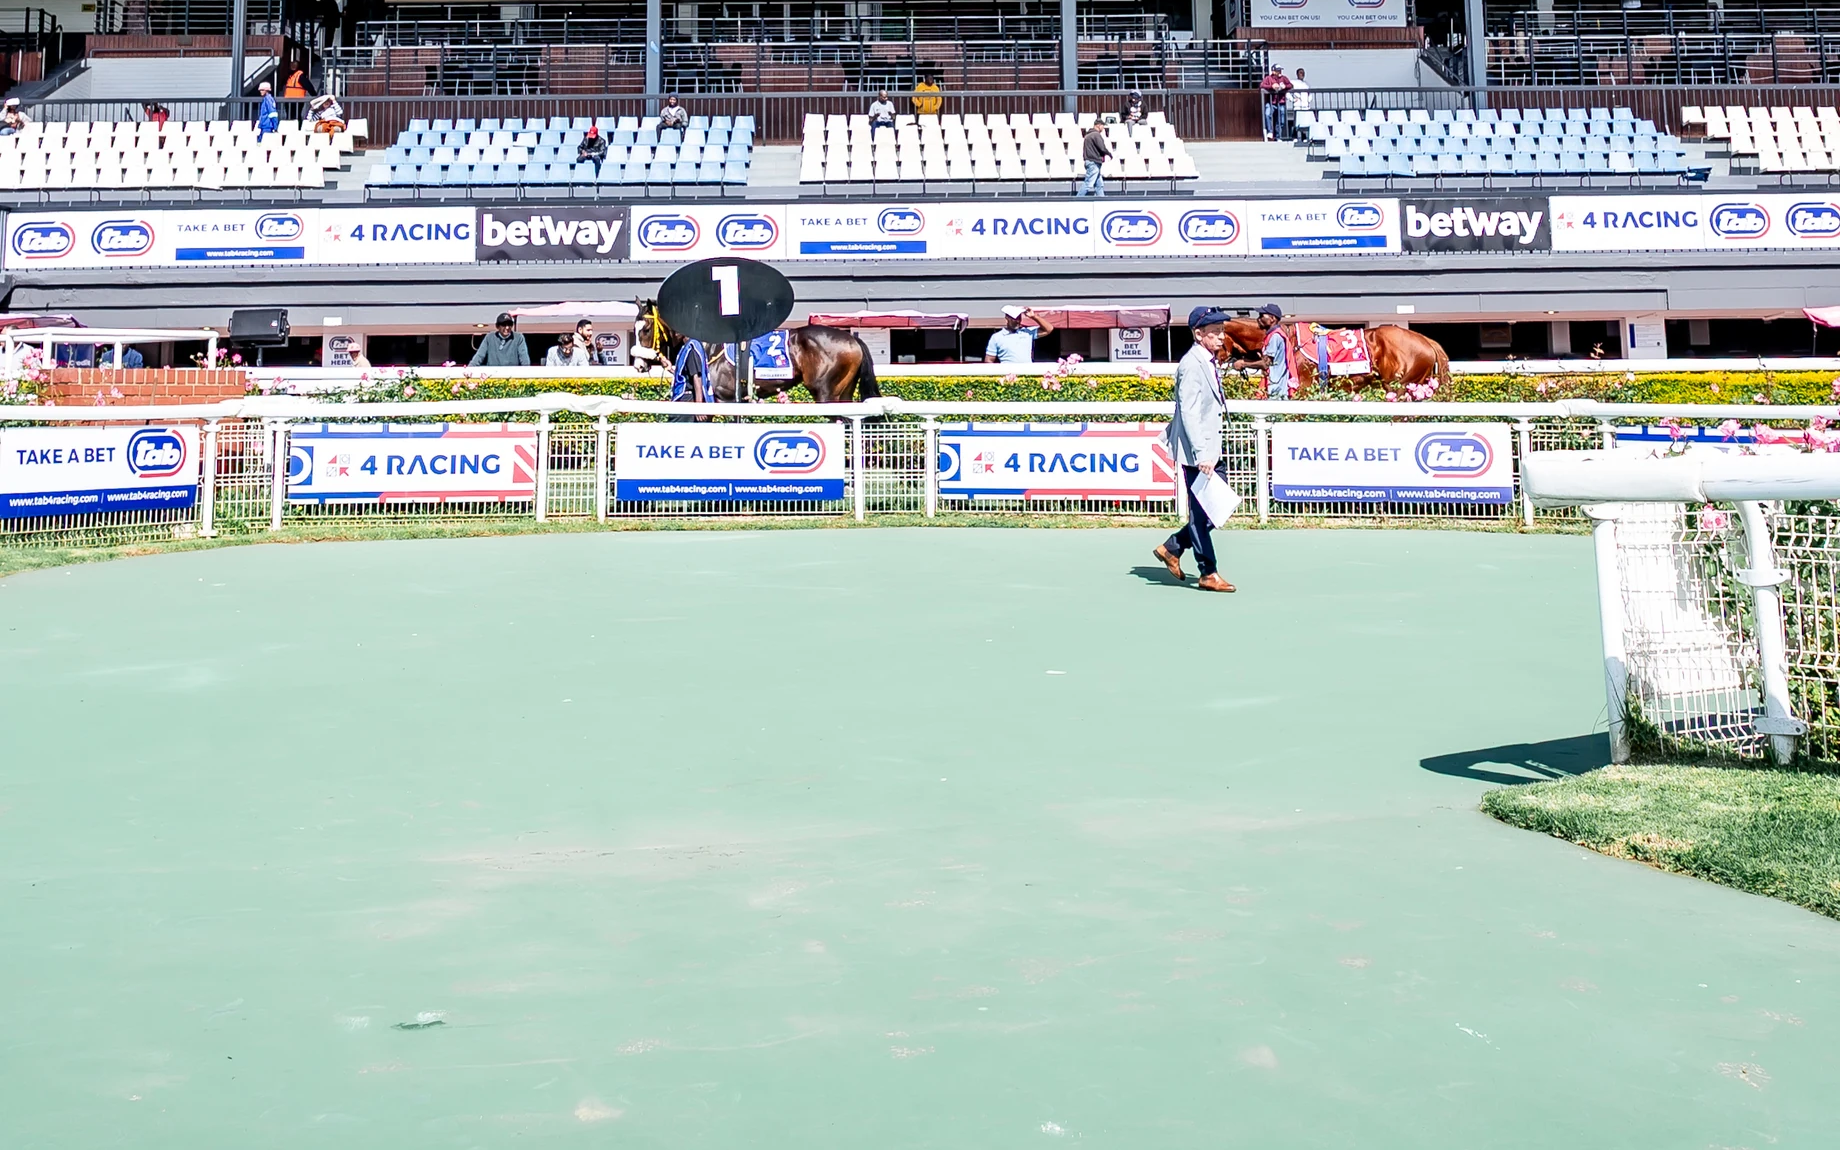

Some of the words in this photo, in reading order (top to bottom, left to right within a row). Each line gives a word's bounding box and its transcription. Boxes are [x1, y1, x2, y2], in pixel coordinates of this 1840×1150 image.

[801, 218, 830, 226] TAKE
[835, 218, 843, 226] A
[847, 217, 868, 226] BET
[881, 212, 921, 230] tab
[1261, 213, 1290, 222] TAKE
[1295, 213, 1303, 221] A
[1306, 213, 1327, 221] BET
[1341, 207, 1380, 226] tab
[1406, 205, 1542, 244] betway
[1583, 212, 1597, 228] 4
[1603, 211, 1698, 228] RACING
[1717, 210, 1766, 232] tab
[1793, 209, 1840, 231] tab
[177, 224, 207, 232] TAKE
[212, 224, 220, 232] A
[224, 223, 246, 232] BET
[260, 218, 300, 236] tab
[350, 224, 365, 241] 4
[372, 223, 470, 241] RACING
[482, 214, 622, 253] betway
[645, 222, 695, 243] tab
[723, 221, 773, 243] tab
[971, 219, 986, 235] 4
[993, 218, 1089, 235] RACING
[1108, 218, 1158, 240] tab
[1186, 218, 1235, 240] tab
[19, 230, 69, 251] tab
[99, 228, 149, 249] tab
[830, 243, 897, 251] www.tab4racing.com
[1291, 238, 1357, 247] www.tab4racing.com
[206, 250, 274, 258] www.tab4racing.com
[711, 265, 741, 316] 1
[767, 335, 782, 356] 2
[1340, 330, 1358, 350] 3
[16, 449, 63, 465] TAKE
[67, 448, 79, 463] A
[84, 447, 116, 463] BET
[134, 440, 182, 467] tab
[636, 445, 685, 459] TAKE
[690, 445, 704, 459] A
[708, 445, 745, 459] BET
[763, 439, 820, 465] tab
[1287, 447, 1340, 461] TAKE
[1344, 448, 1359, 462] A
[1363, 447, 1402, 462] BET
[1425, 441, 1486, 468] tab
[360, 454, 378, 475] 4
[386, 454, 501, 475] RACING
[1004, 453, 1021, 473] 4
[1028, 453, 1140, 473] RACING
[9, 493, 98, 507] www.tab4racing.com
[107, 488, 188, 502] www.tab4racing.com
[638, 484, 727, 495] www.tab4racing.com
[734, 484, 823, 495] www.tab4racing.com
[1285, 487, 1386, 499] www.tab4racing.com
[1396, 489, 1501, 500] www.tab4racing.com
